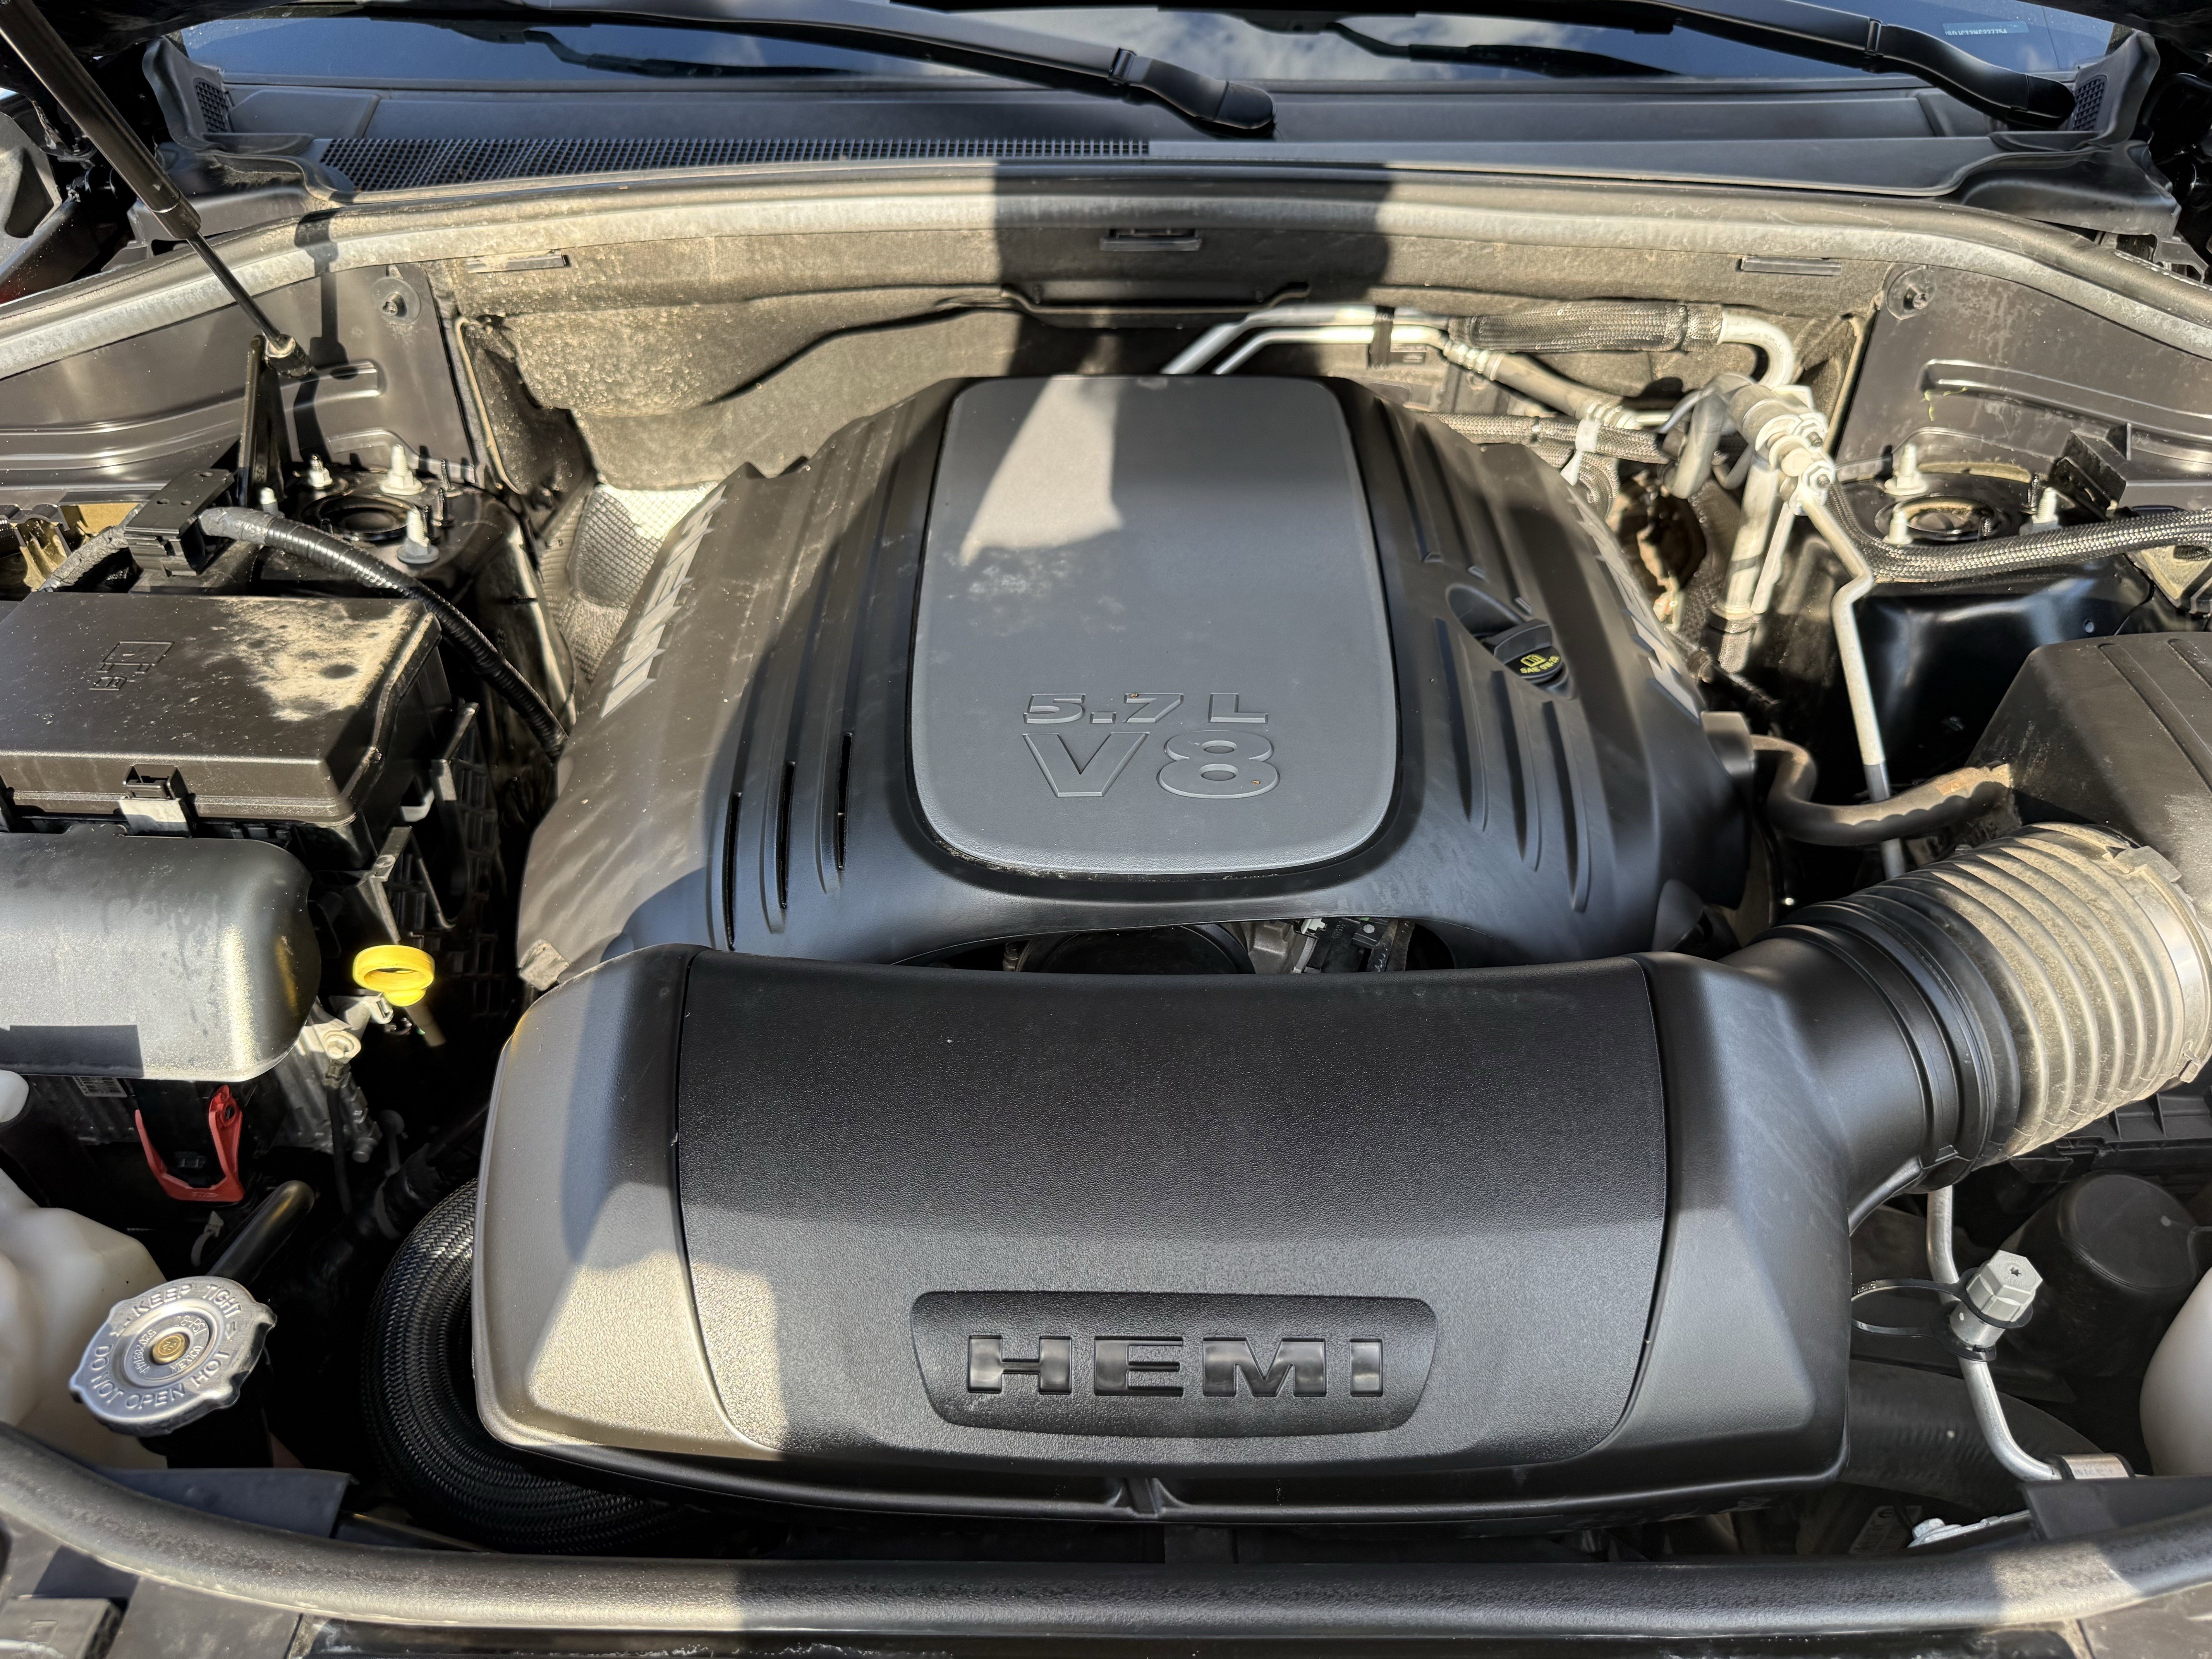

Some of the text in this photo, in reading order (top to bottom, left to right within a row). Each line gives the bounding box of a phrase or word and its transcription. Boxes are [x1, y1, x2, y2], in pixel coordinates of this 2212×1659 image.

[1540, 655, 1560, 670] 0W-20
[1024, 693, 1268, 724] 5.7 L
[1022, 730, 1280, 799] V8
[132, 1284, 242, 1318] KEEP TIGHT
[169, 1345, 203, 1373] MEXICO
[968, 1334, 1383, 1397] HEMI
[91, 1345, 229, 1409] DO NOT OPEN HOT
